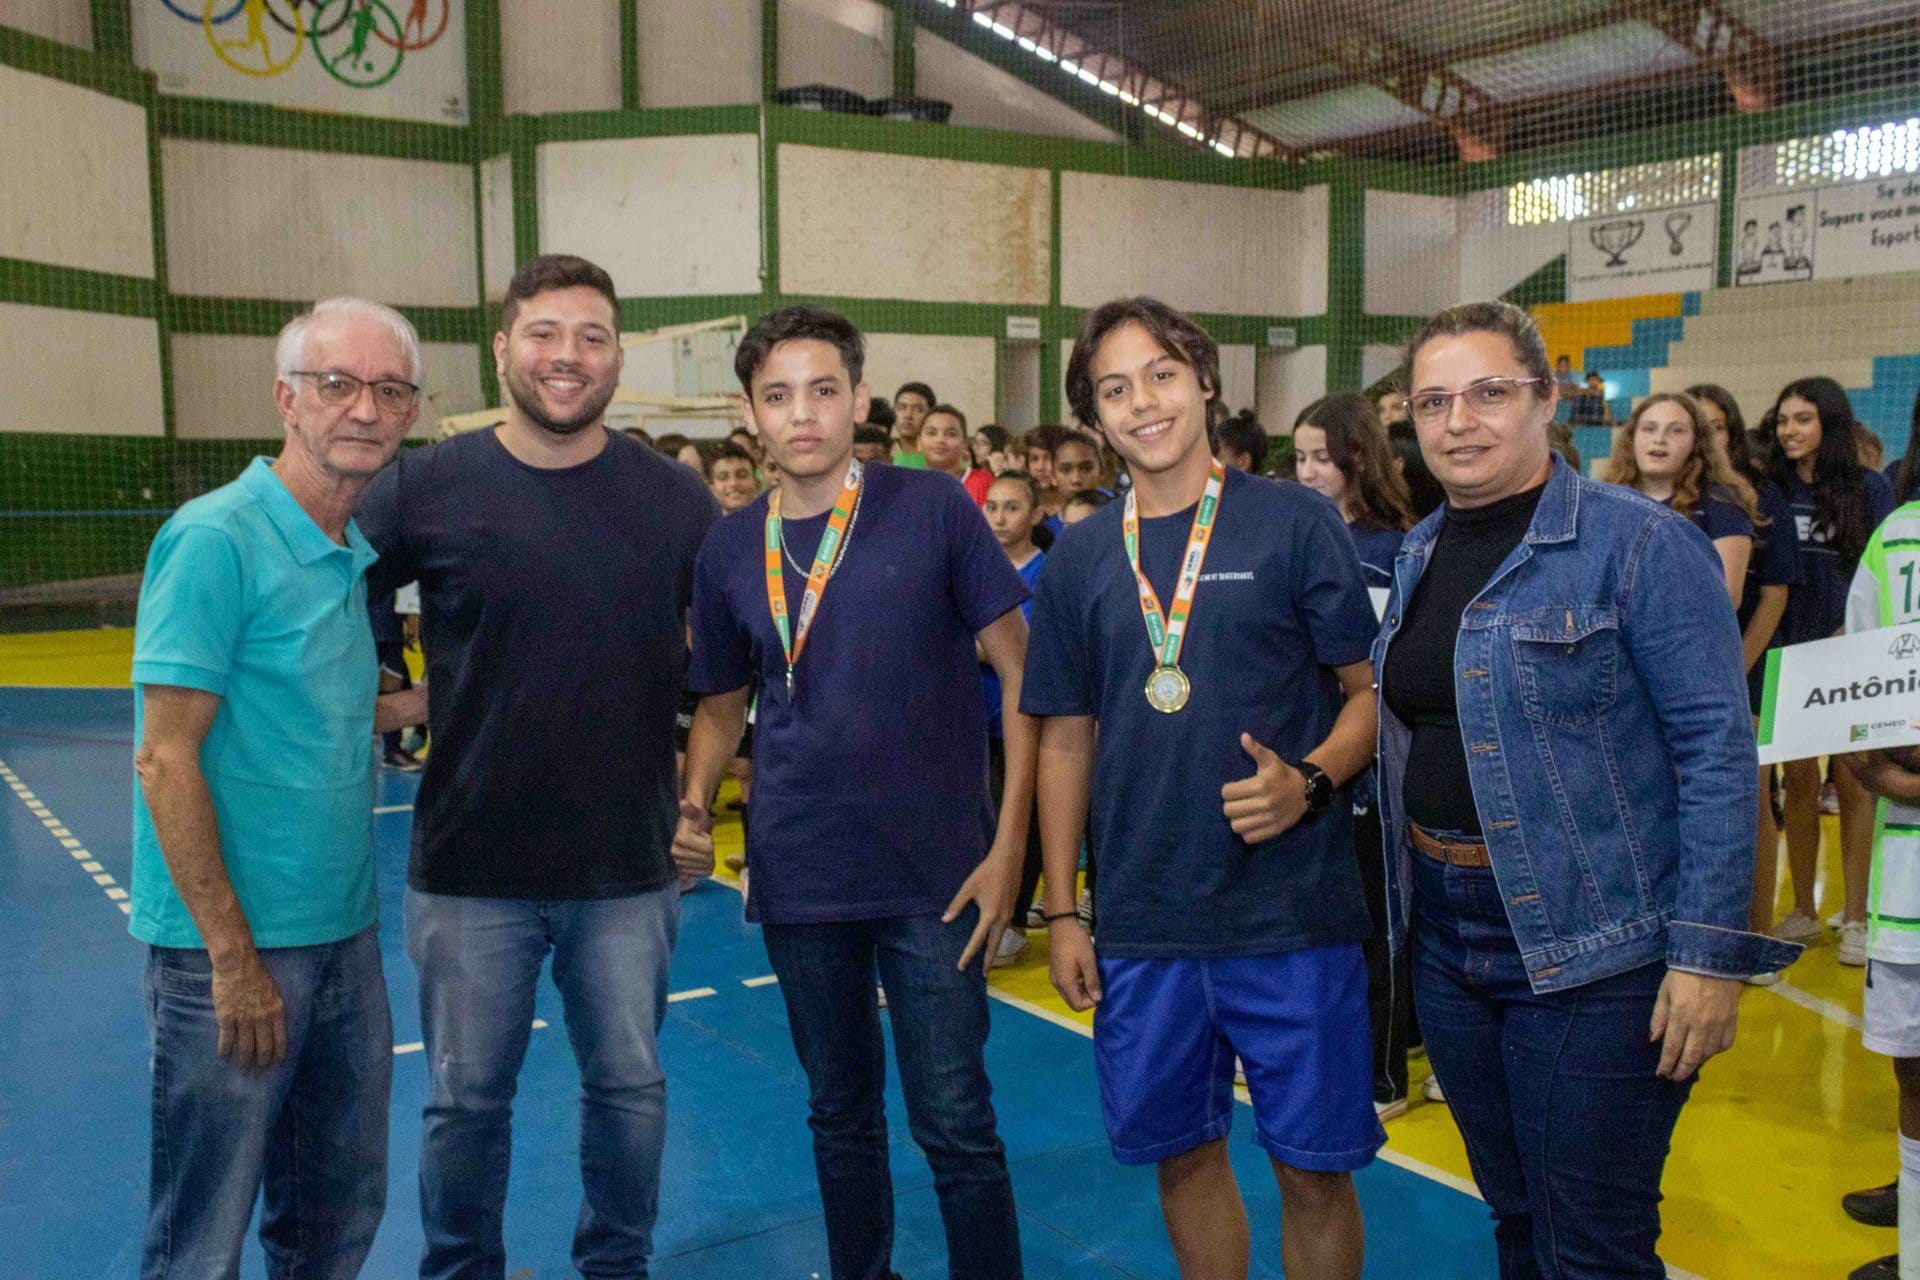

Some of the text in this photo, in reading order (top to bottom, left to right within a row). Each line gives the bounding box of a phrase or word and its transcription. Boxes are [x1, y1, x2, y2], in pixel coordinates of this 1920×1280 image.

[1819, 210, 1865, 229] Supere
[1899, 560, 1920, 613] 1
[1803, 669, 1920, 709] Antôni
